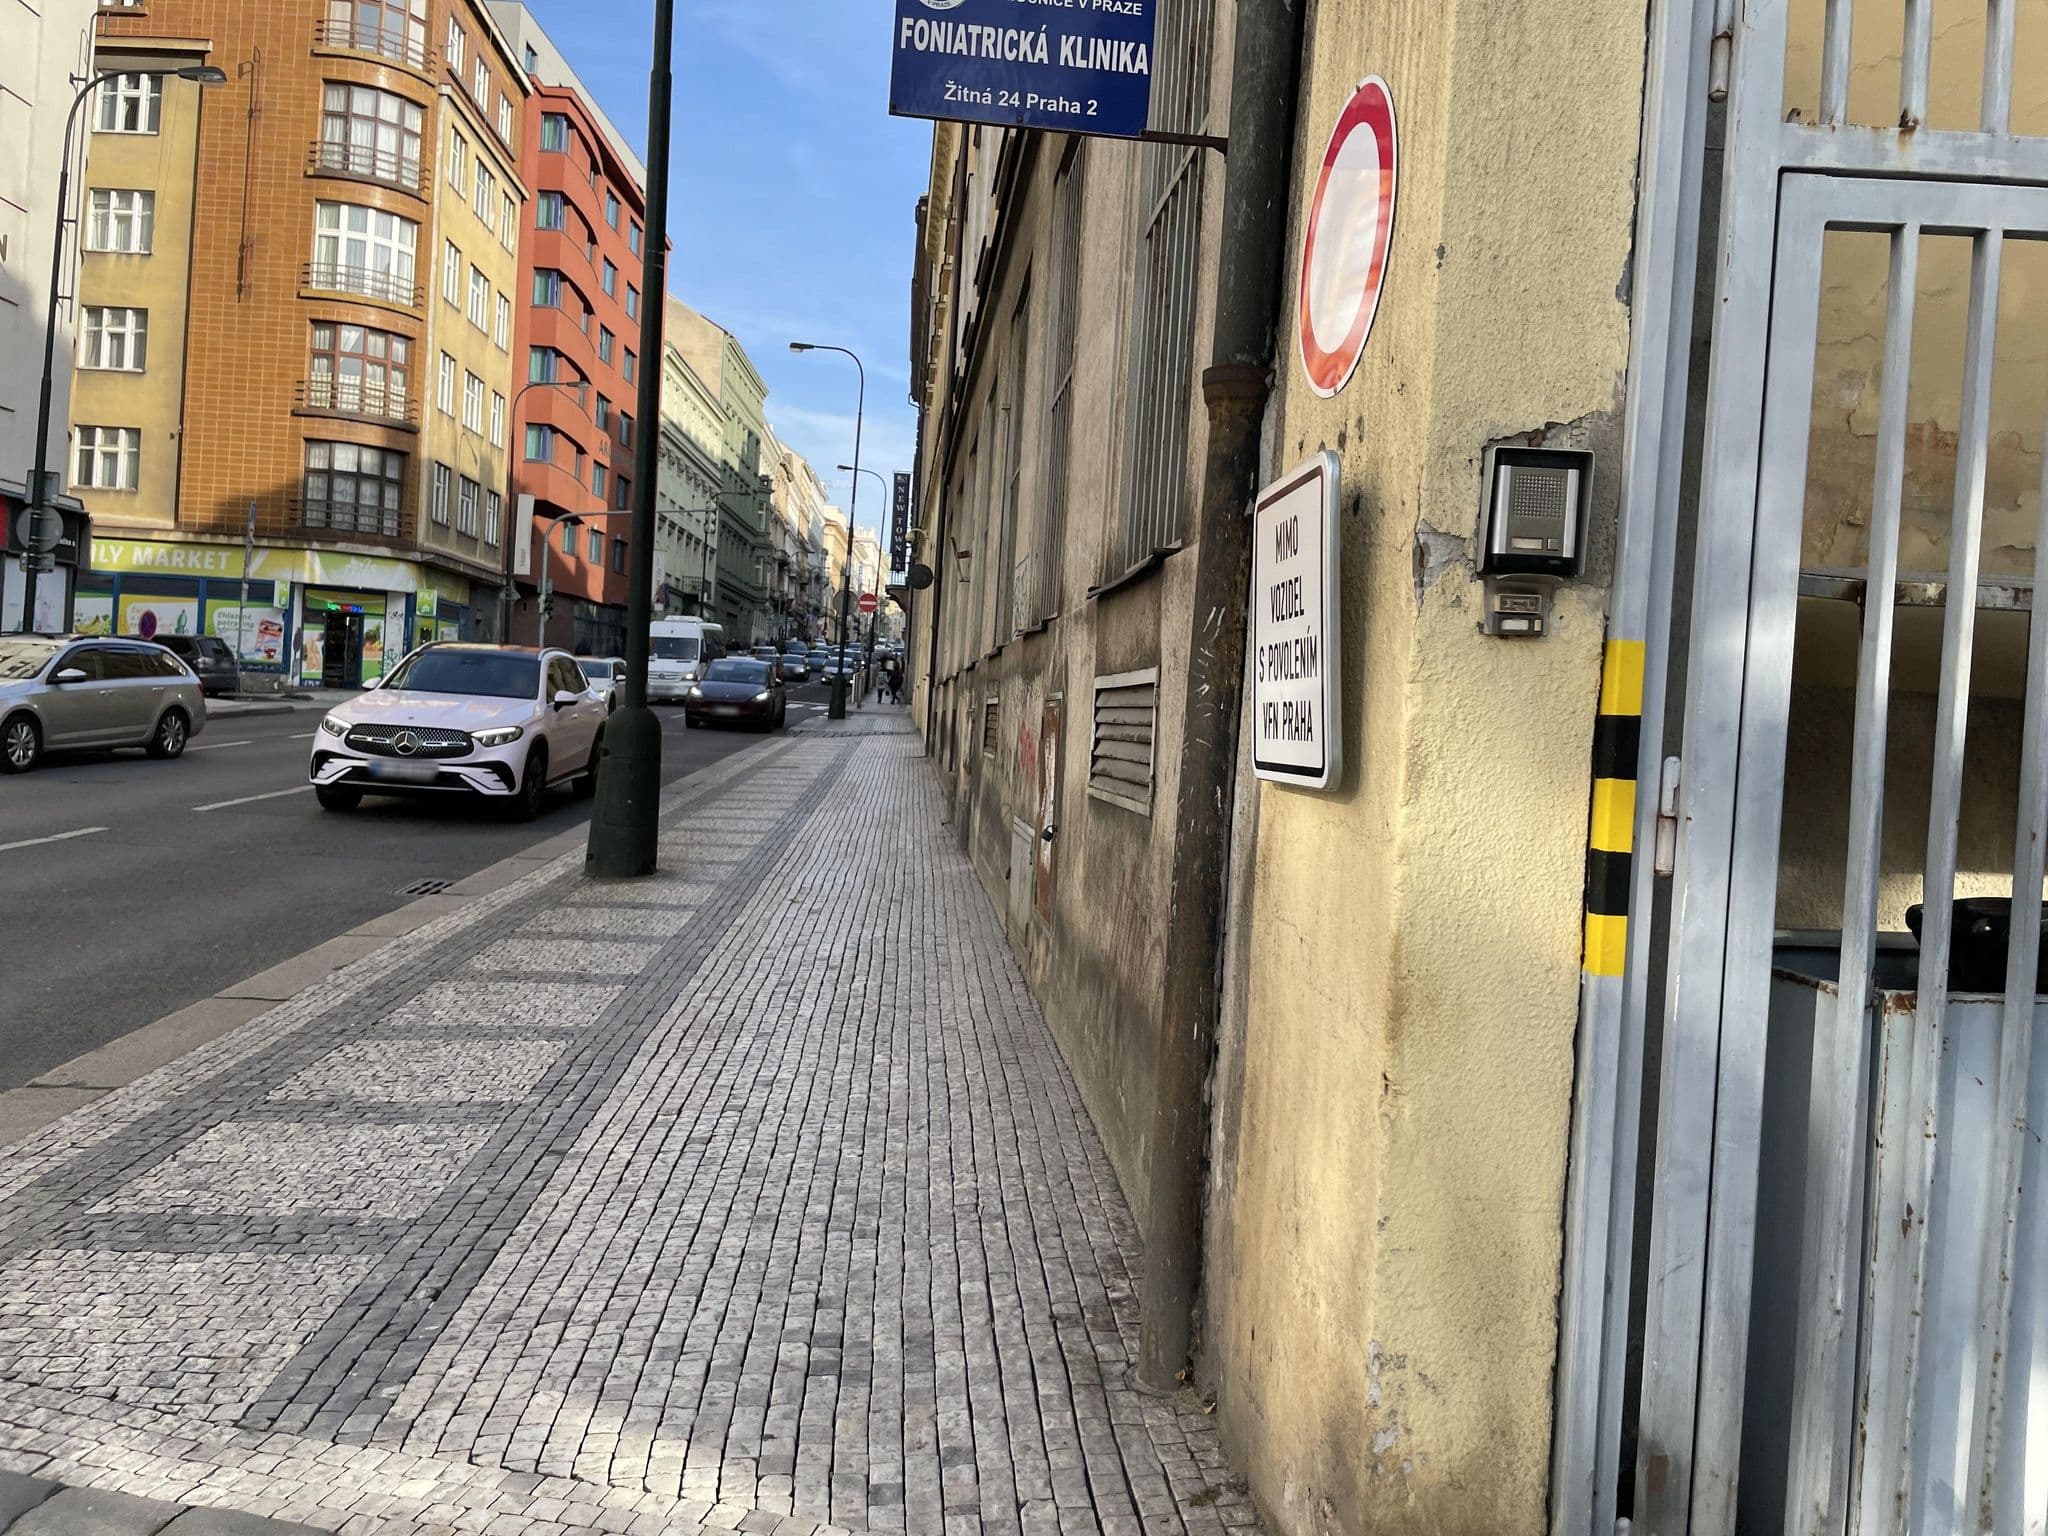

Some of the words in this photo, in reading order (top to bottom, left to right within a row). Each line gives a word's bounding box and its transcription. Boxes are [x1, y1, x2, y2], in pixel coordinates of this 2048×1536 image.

[1092, 0, 1143, 16] PRAZE
[900, 17, 1049, 65] FONIATRICKÁ
[1059, 35, 1149, 75] KLINIKA
[944, 80, 992, 105] Žitná
[998, 90, 1020, 108] 24
[1026, 93, 1081, 115] Praha
[1087, 99, 1098, 116] 2
[896, 486, 905, 511] NEW
[895, 517, 904, 552] TOWN
[1275, 514, 1299, 564] MIMO
[132, 546, 231, 570] MARKET
[1270, 575, 1304, 624] VOZIDEL
[1259, 646, 1265, 683] S
[1268, 625, 1318, 682] POVOLENÍM
[1263, 702, 1279, 740] VFN
[1282, 700, 1313, 742] PRAHA
